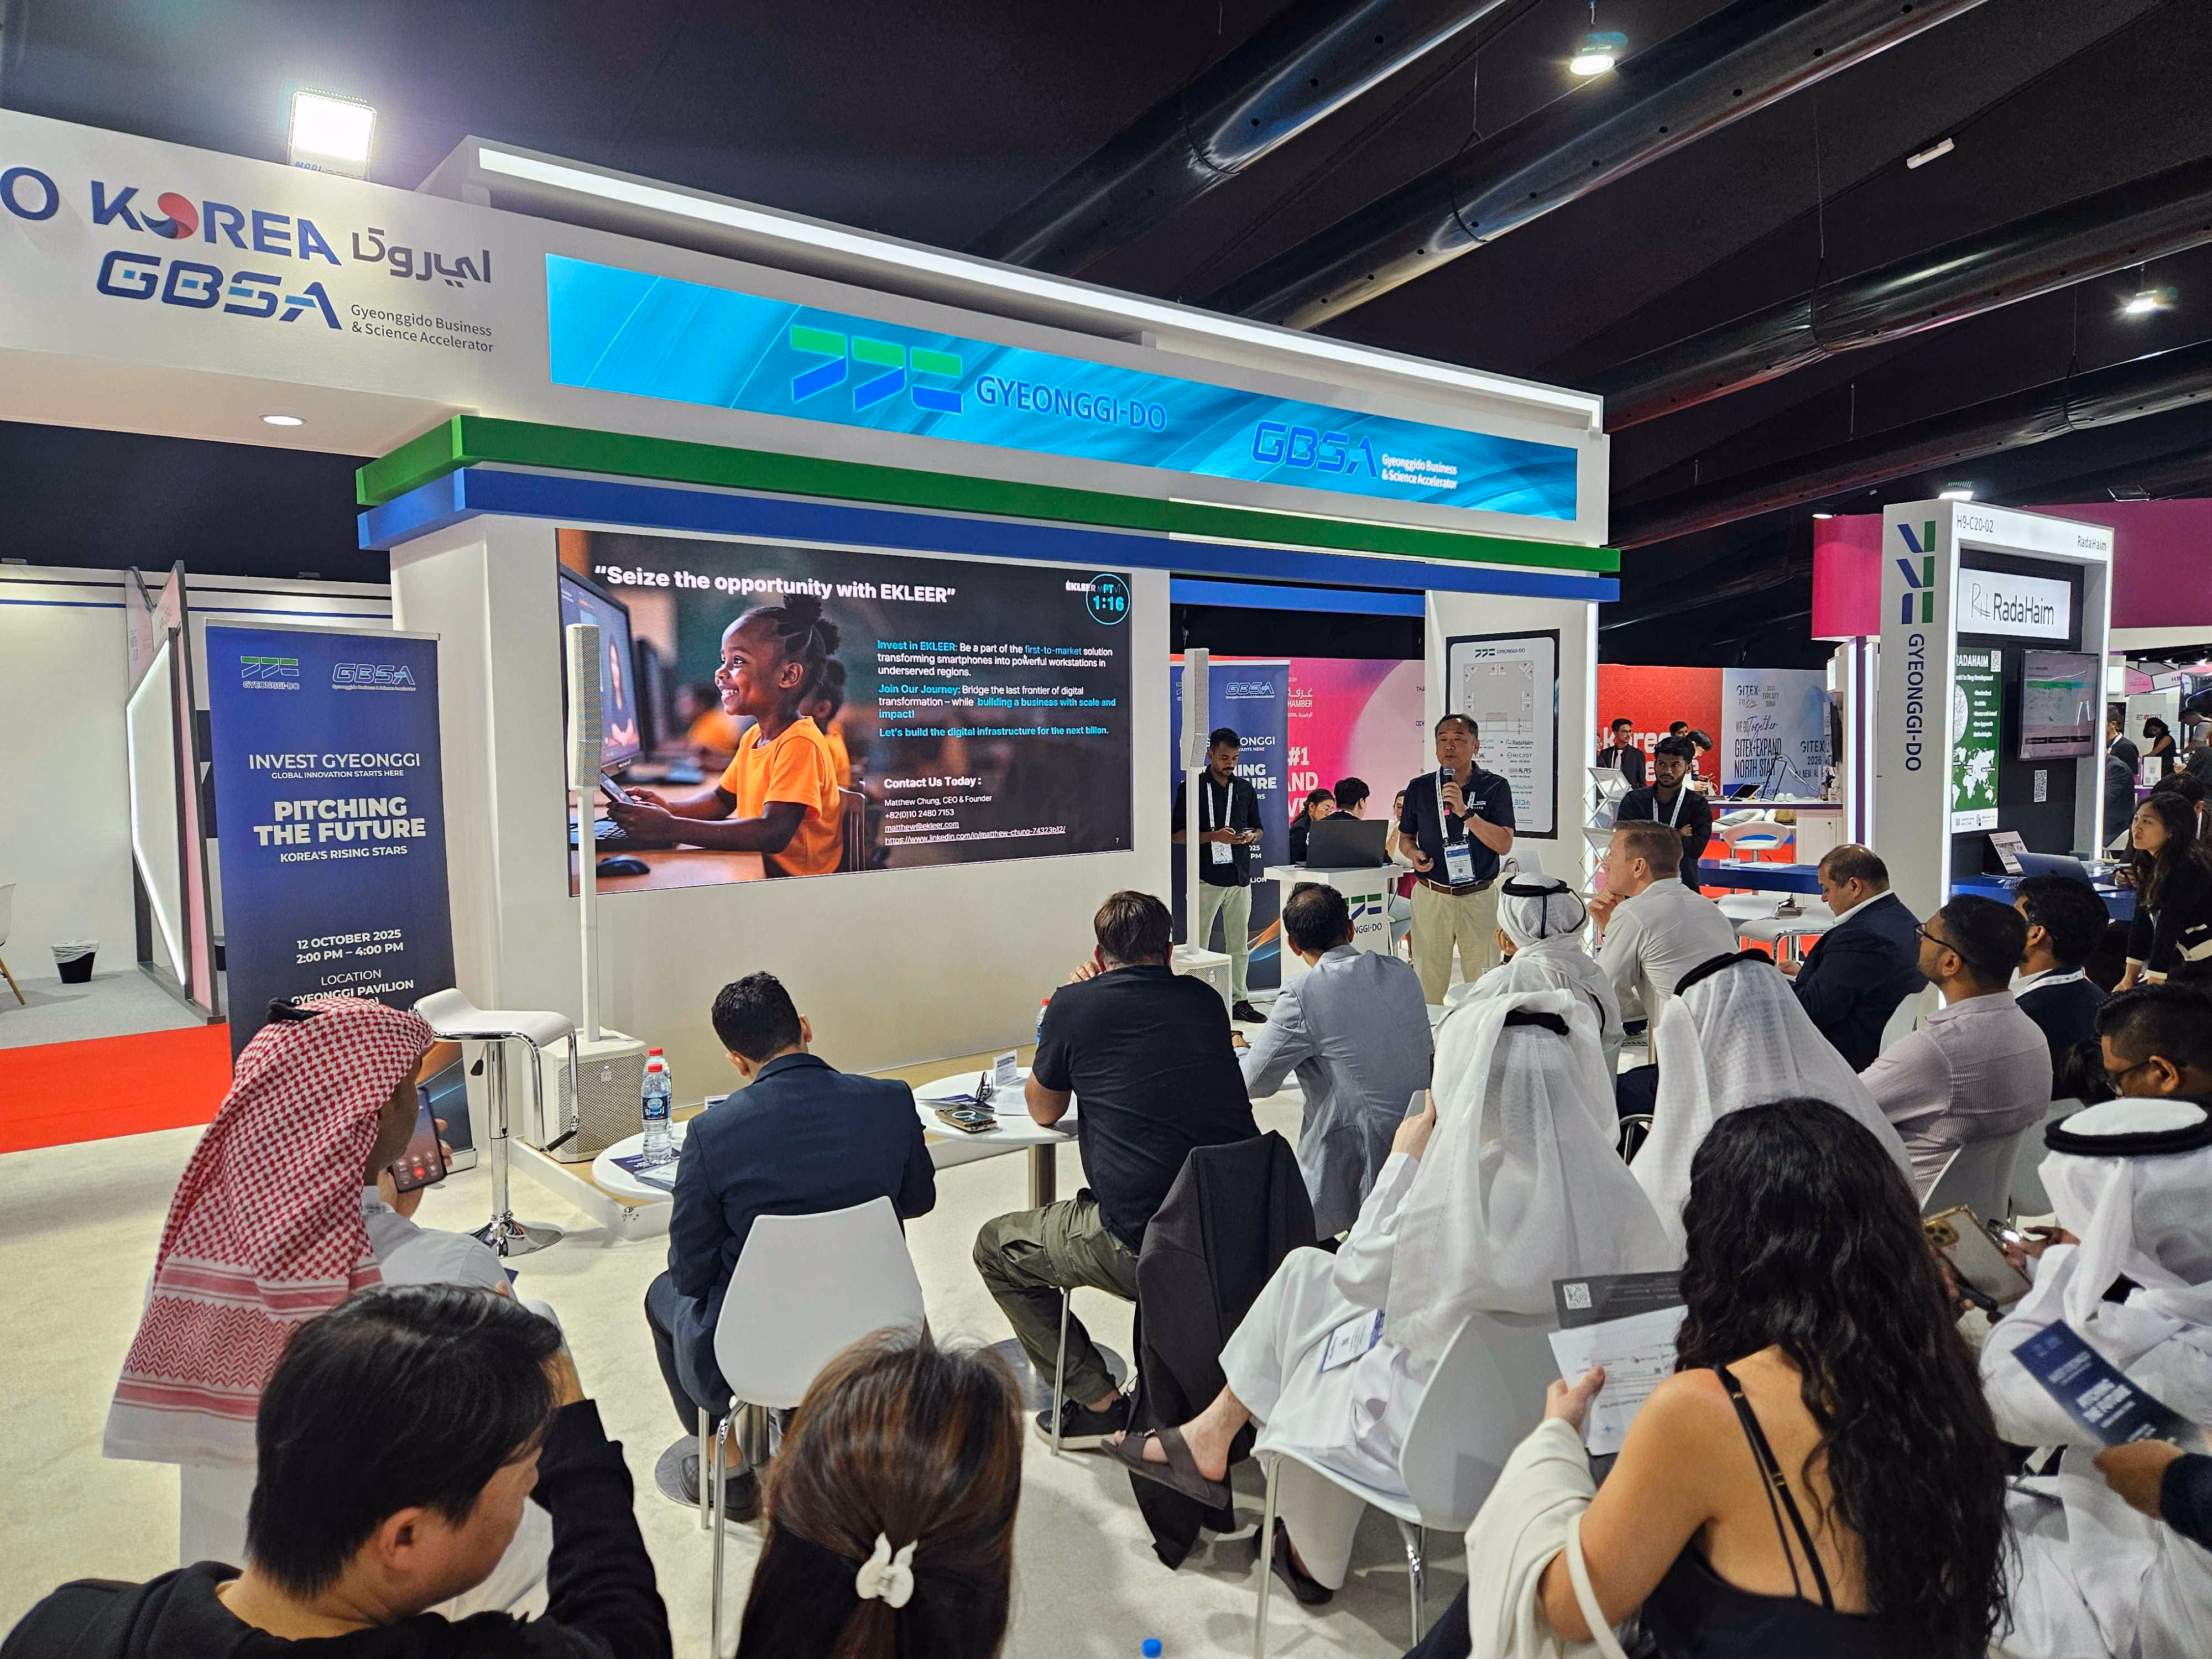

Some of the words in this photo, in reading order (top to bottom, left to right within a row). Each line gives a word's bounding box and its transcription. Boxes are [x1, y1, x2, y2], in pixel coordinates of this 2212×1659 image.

[96, 251, 342, 330] GBSA
[351, 304, 432, 327] Gyeonggido
[436, 317, 492, 337] Business
[351, 321, 362, 333] &
[365, 323, 417, 342] Science
[420, 332, 494, 353] Accelerator
[976, 375, 1167, 431] GYEONGGI-DO
[1252, 421, 1378, 478] GBSA
[1382, 453, 1426, 472] Gyeonggido
[1426, 460, 1458, 475] Business
[1389, 469, 1417, 484] Science
[1417, 474, 1458, 489] Accelerator
[1957, 514, 1994, 533] H9-C20-02
[2077, 535, 2107, 552] RadaHaim
[674, 571, 711, 589] the
[714, 575, 833, 600] opportunity
[836, 581, 877, 599] with
[1093, 595, 1124, 611] 1:16
[1993, 593, 2054, 625] RadaHaim
[877, 640, 907, 650] Invest
[909, 640, 918, 650] in
[920, 641, 958, 651] EKLEER:
[959, 643, 971, 652] Be
[980, 644, 997, 654] part
[999, 644, 1008, 653] of
[1009, 644, 1023, 654] the
[1025, 645, 1082, 656] first-to-market
[1083, 647, 1113, 656] solution
[877, 653, 935, 665] transforming
[937, 655, 993, 666] smartphones
[994, 655, 1010, 665] into
[1012, 656, 1047, 667] powerful
[1048, 658, 1098, 667] workstations
[1099, 659, 1106, 667] in
[332, 663, 415, 685] GBSA
[878, 666, 935, 676] underserved
[937, 667, 972, 678] regions.
[243, 681, 300, 691] GYEONGGI-DO
[878, 684, 899, 693] Join
[901, 684, 919, 694] Our
[921, 685, 960, 696] Journey:
[962, 685, 989, 695] Bridge
[991, 686, 1005, 695] the
[1006, 686, 1020, 695] last
[1022, 686, 1050, 695] frontier
[1051, 686, 1060, 695] of
[1061, 687, 1084, 697] digital
[1225, 682, 1274, 695] GBSA
[1736, 685, 1759, 696] GITEX
[879, 697, 943, 706] transformation
[952, 697, 974, 707] while
[977, 697, 1013, 708] building
[1021, 698, 1058, 707] business
[1060, 698, 1077, 707] with
[1079, 698, 1100, 707] scale
[1101, 698, 1116, 707] and
[1906, 633, 1924, 771] GYEONGGI-DO
[879, 709, 915, 720] impact!
[905, 728, 928, 737] build
[930, 728, 945, 736] the
[947, 727, 975, 738] digital
[977, 727, 1036, 736] infrastructure
[1037, 727, 1050, 735] for
[1051, 727, 1065, 735] the
[1066, 727, 1084, 735] next
[1736, 721, 1743, 732] WE
[1743, 721, 1749, 732] GO
[1747, 715, 1778, 742] Together
[1240, 736, 1275, 745] ONGGI
[1801, 740, 1825, 753] GITEX
[249, 754, 317, 770] INVEST
[322, 753, 420, 769] GYEONGGI
[1734, 760, 1757, 778] NORTH
[1759, 759, 1775, 776] STAR
[1807, 756, 1822, 765] 2026
[884, 778, 927, 789] Contact
[928, 777, 943, 787] Us
[944, 776, 977, 787] Today
[274, 797, 408, 821] PITCHING
[917, 797, 941, 806] Chung,
[965, 795, 992, 803] Founder
[885, 811, 917, 820] +82(0)10
[918, 810, 937, 818] 2480
[253, 823, 311, 846] THE
[318, 818, 426, 843] FUTURE
[885, 821, 959, 833] matthew@ekleer.com
[280, 851, 328, 863] KOREA'S
[330, 848, 370, 859] RISING
[372, 846, 408, 856] STARS
[1354, 922, 1382, 934] NGGI-DO
[297, 939, 309, 950] 12
[311, 932, 371, 948] OCTOBER
[373, 928, 401, 941] 2025
[296, 952, 321, 964] 2:00
[324, 948, 343, 960] PM
[355, 944, 382, 956] 4:00
[384, 942, 404, 952] PM
[320, 969, 382, 985] LOCATION
[290, 990, 354, 1005] GYEONGGI
[357, 979, 414, 997] PAVILION
